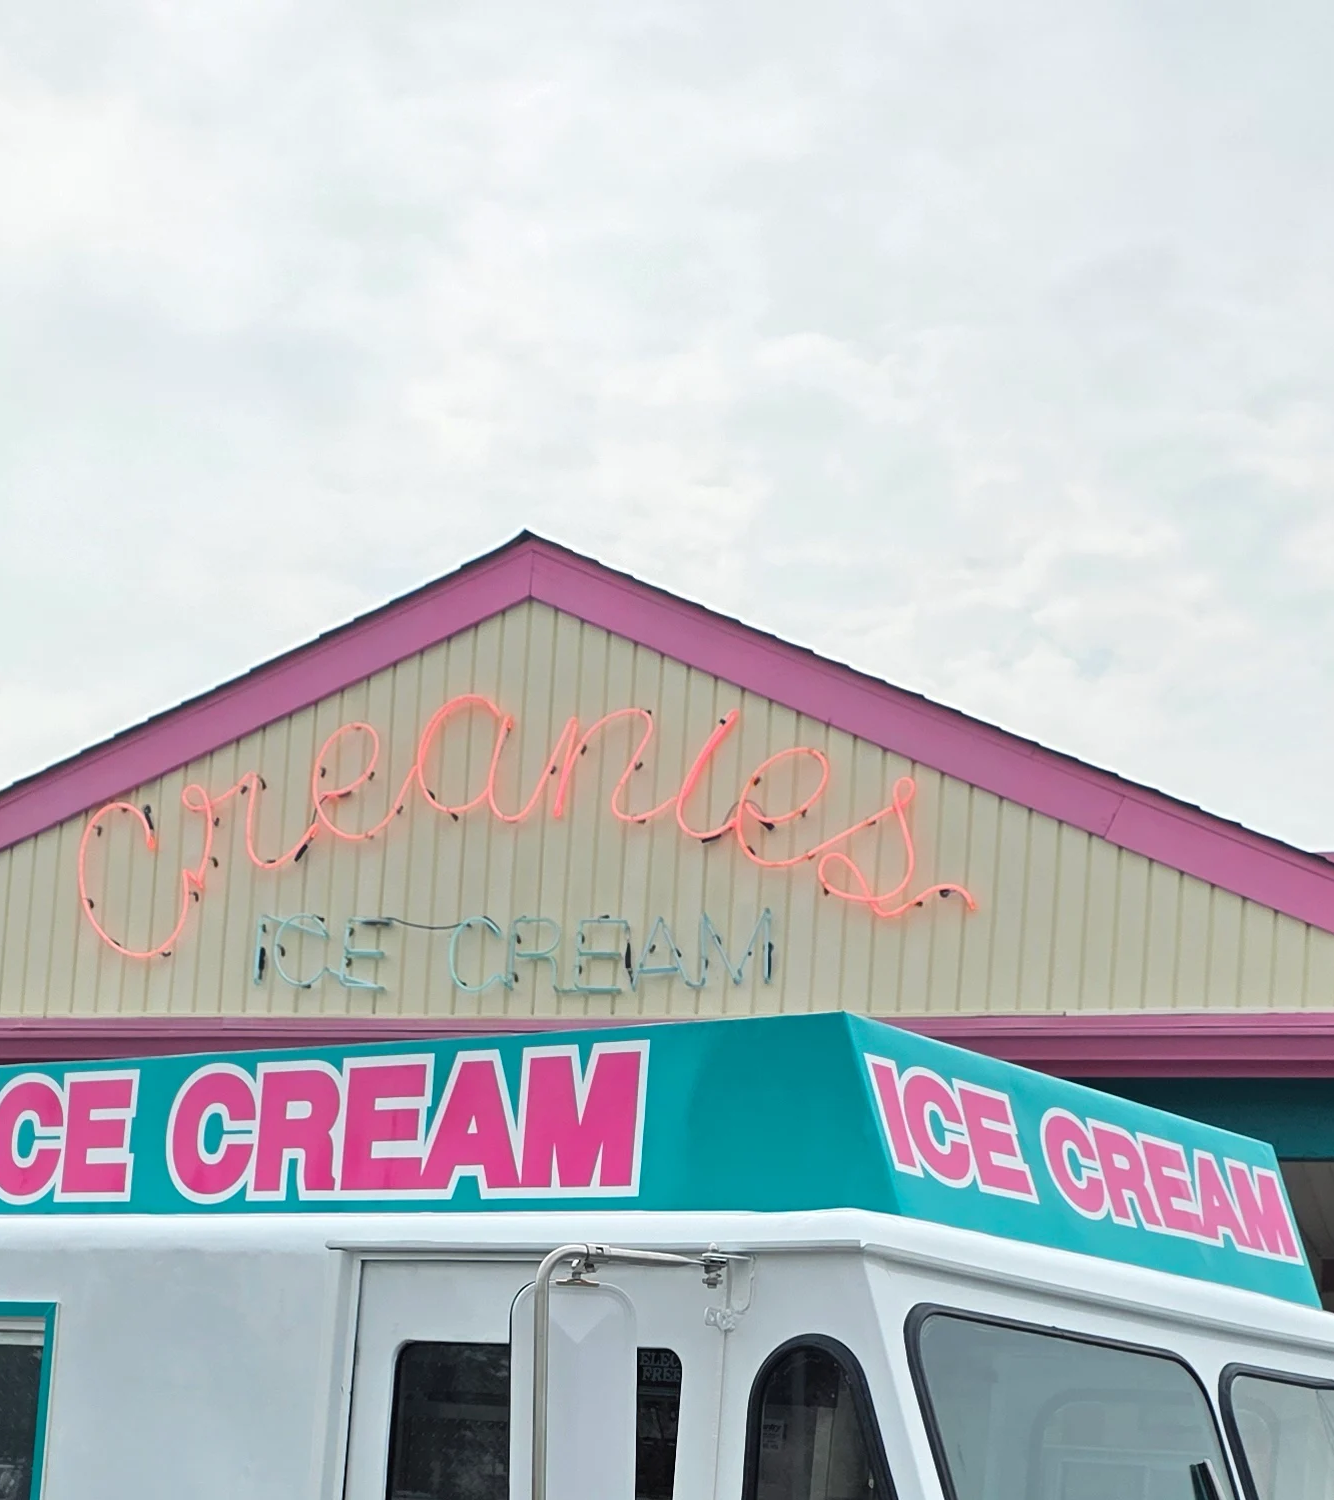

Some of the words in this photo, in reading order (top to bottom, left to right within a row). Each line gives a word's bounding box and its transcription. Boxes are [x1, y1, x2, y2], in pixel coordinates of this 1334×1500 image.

[78, 694, 977, 959] Creanies
[253, 911, 385, 992] ICE
[449, 907, 776, 993] CREAM
[166, 1039, 650, 1204] CREAM
[863, 1054, 1039, 1205] ICE
[1041, 1107, 1302, 1264] CREAM
